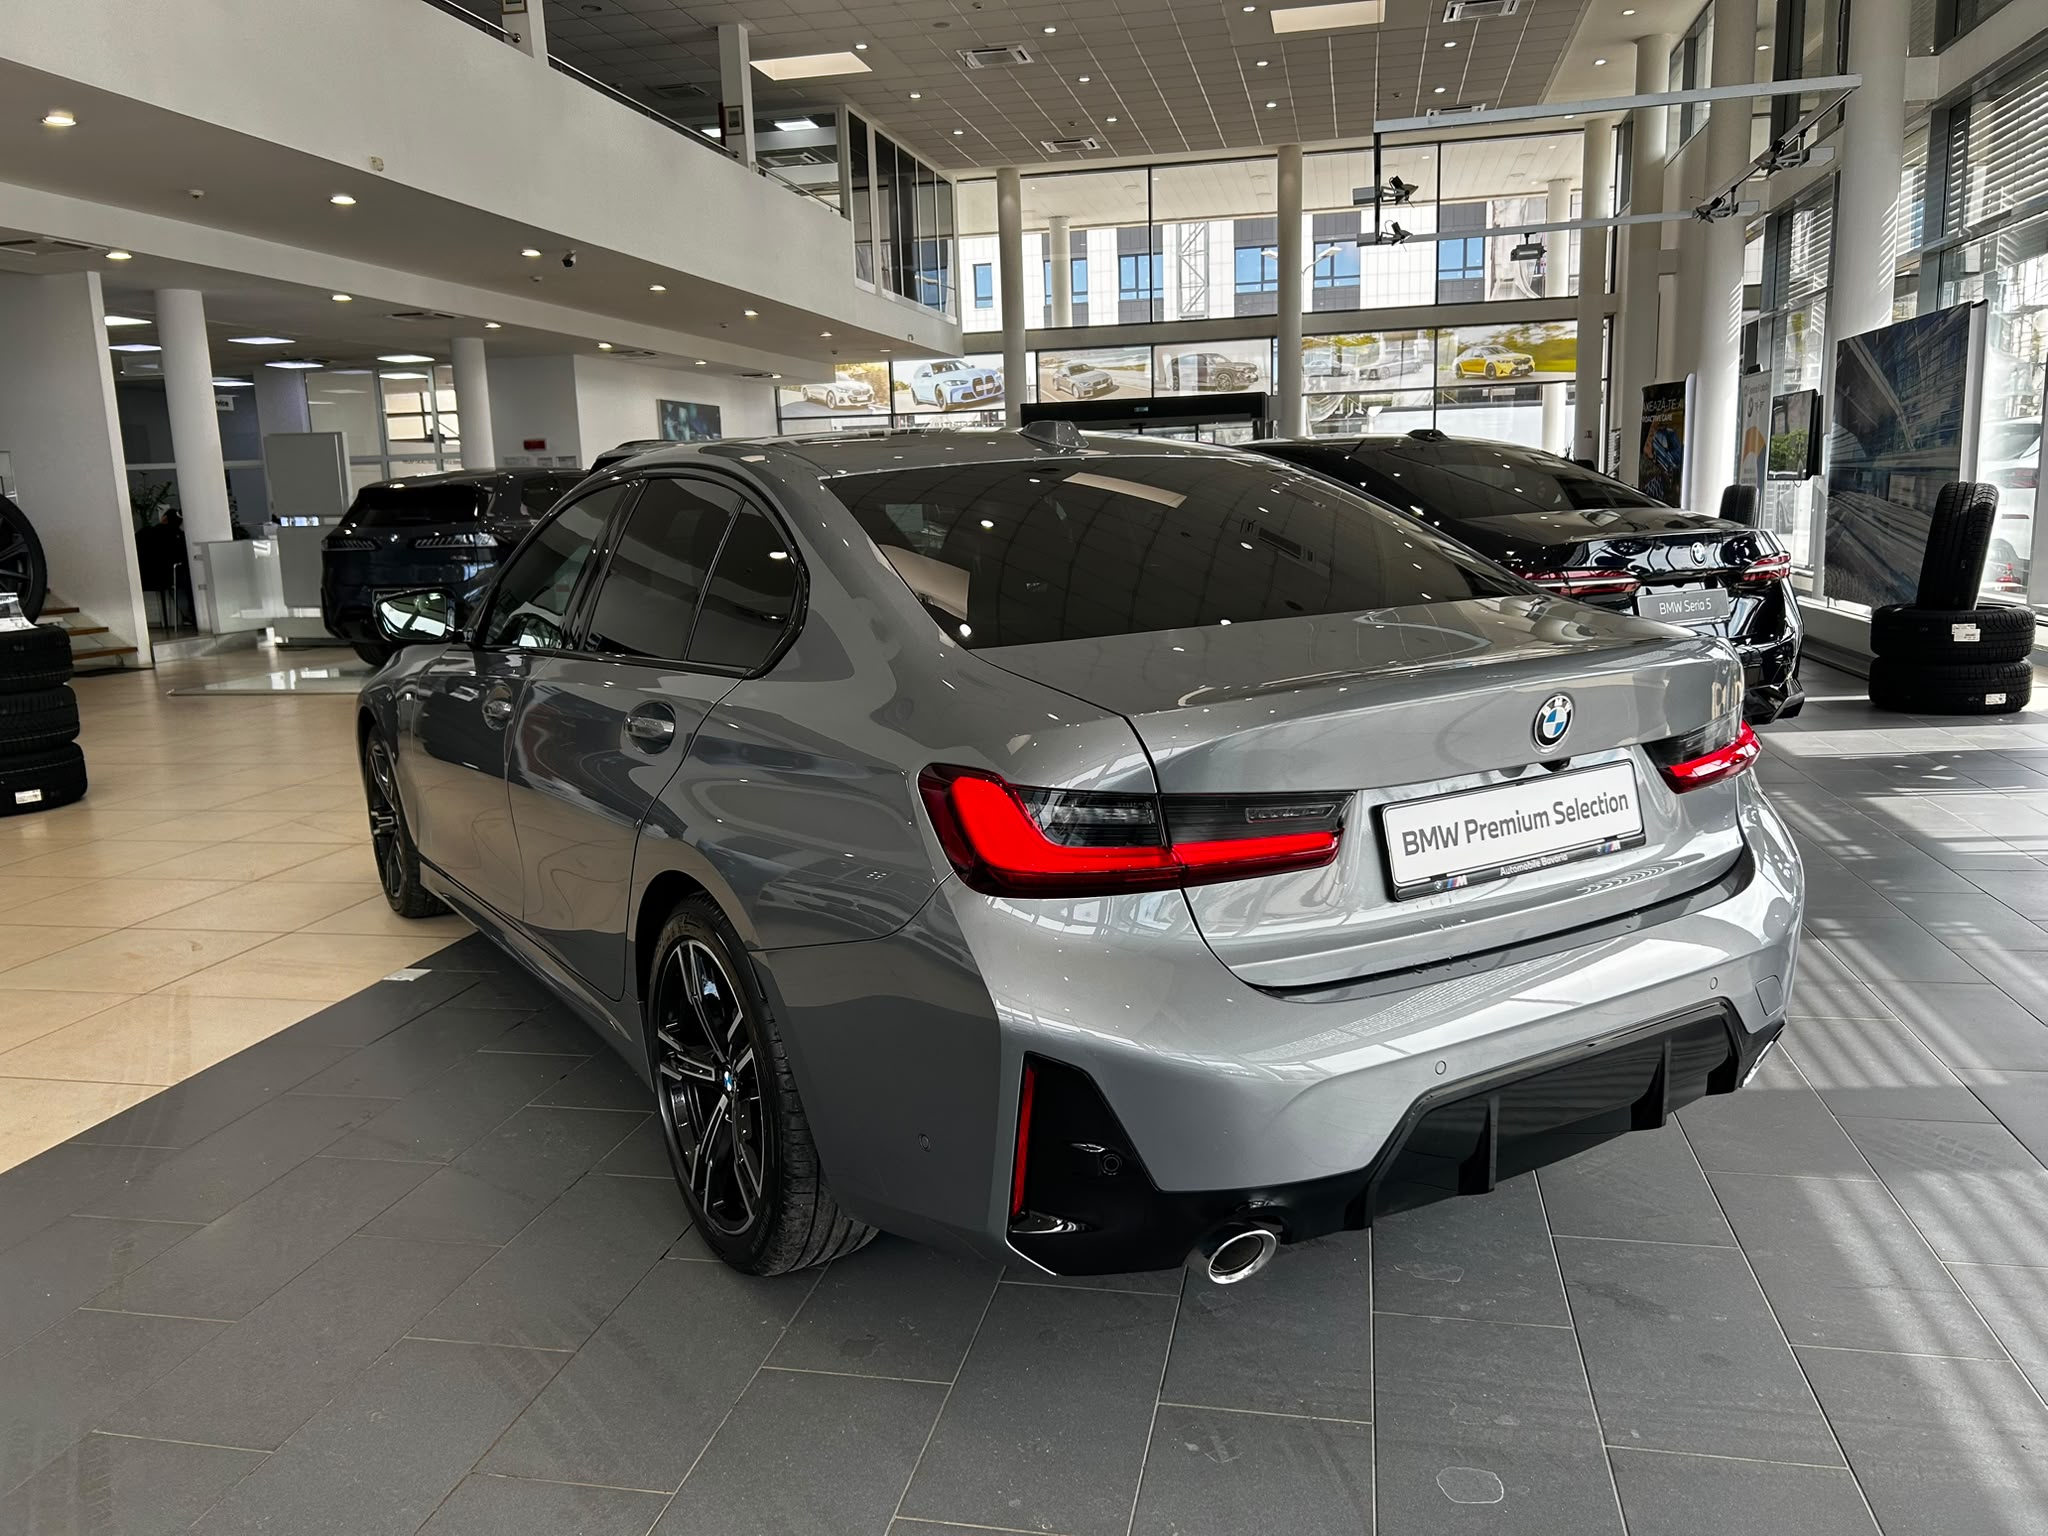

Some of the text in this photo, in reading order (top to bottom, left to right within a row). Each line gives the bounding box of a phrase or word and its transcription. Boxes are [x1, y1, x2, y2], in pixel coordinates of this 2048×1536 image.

[1659, 601, 1682, 615] BMW
[1706, 597, 1712, 610] 5
[1402, 791, 1629, 857] BMW Premium Selection
[1500, 853, 1569, 876] Automobile Bavaria
